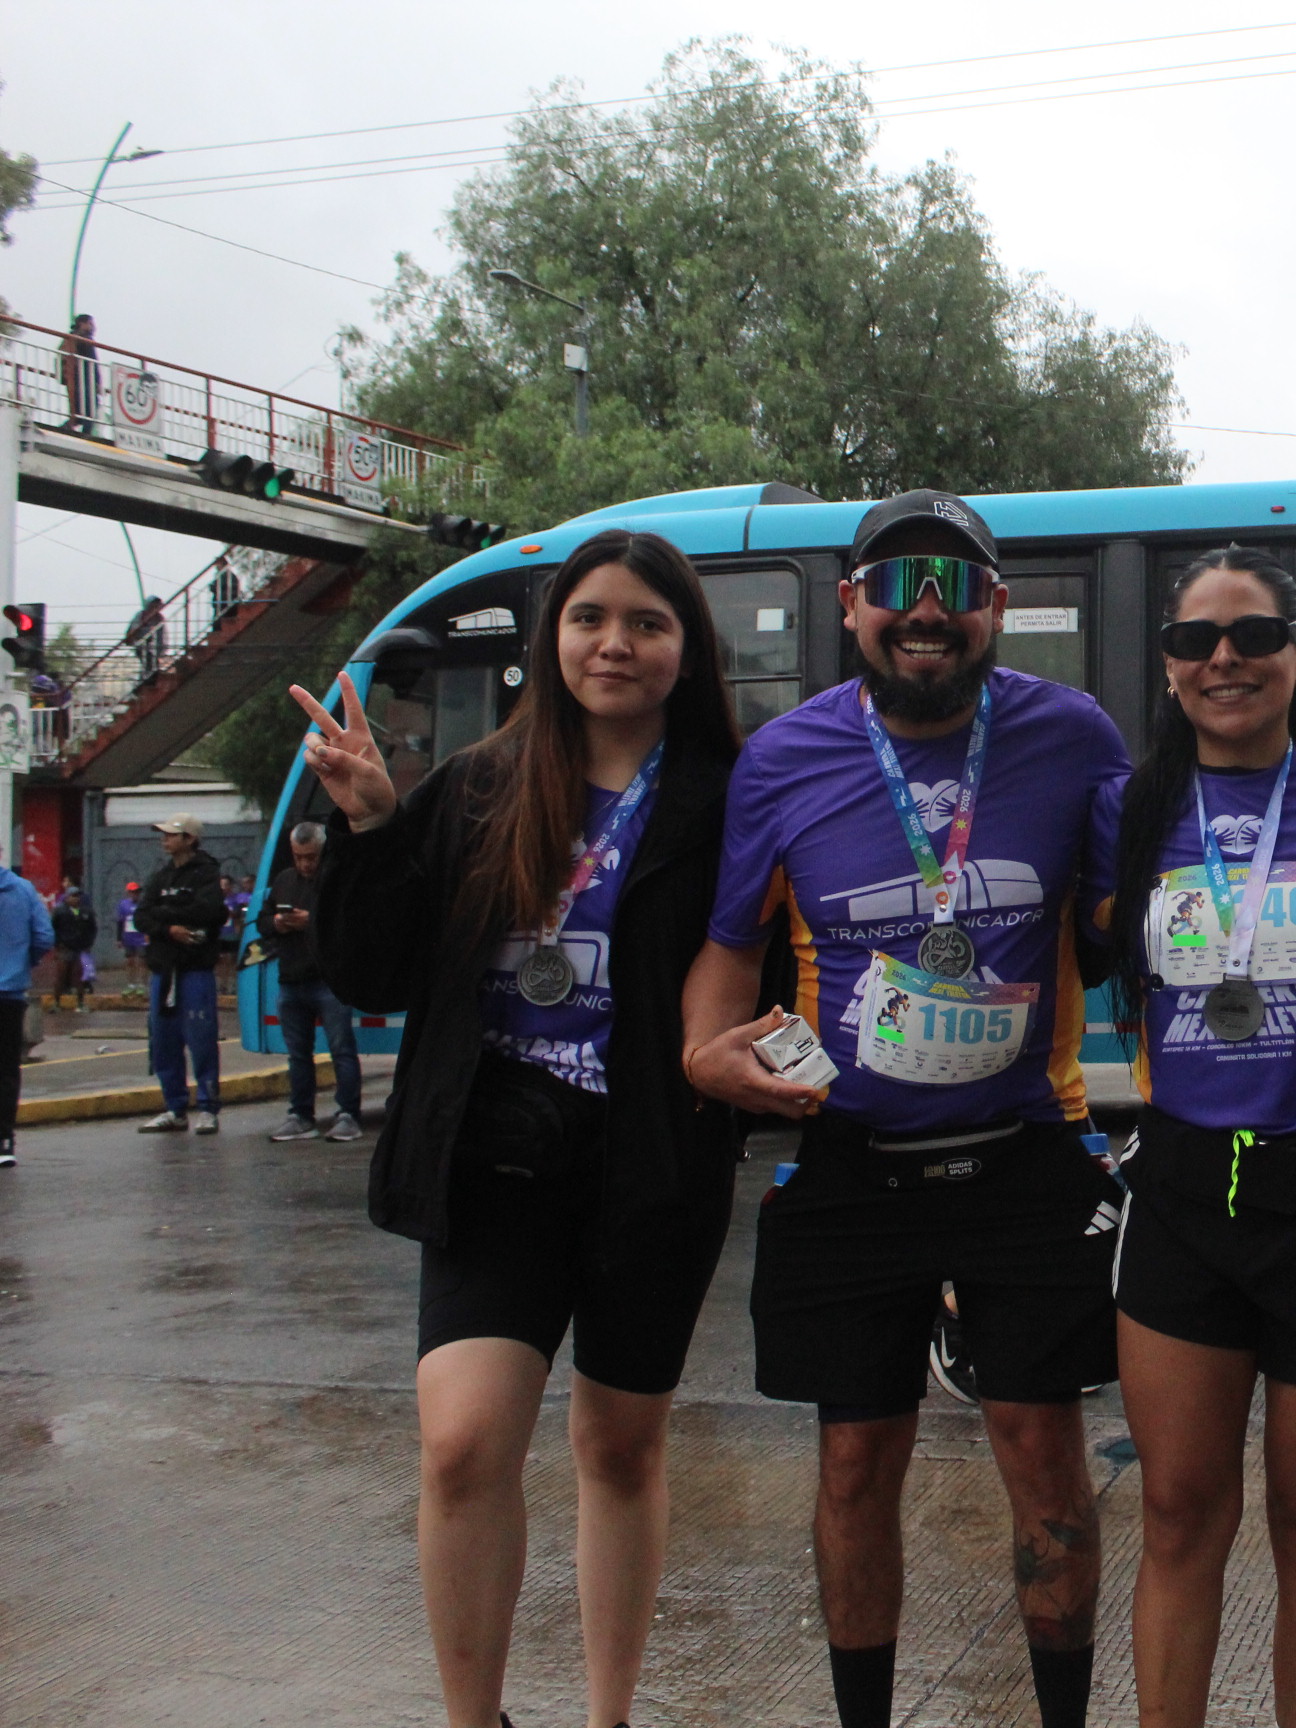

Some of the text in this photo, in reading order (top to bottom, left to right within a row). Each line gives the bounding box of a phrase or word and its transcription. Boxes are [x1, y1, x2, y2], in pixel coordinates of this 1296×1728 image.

[507, 670, 519, 682] 50
[960, 788, 972, 813] 2026
[908, 813, 923, 837] 2026
[593, 833, 611, 853] 2026
[1177, 874, 1198, 883] 2026
[1212, 863, 1225, 886] 2026
[827, 909, 1044, 941] TRANSCONICADOR
[892, 970, 907, 981] 2026
[919, 1003, 1013, 1045] 1105
[947, 1160, 973, 1169] ADIDAS
[949, 1167, 973, 1175] SPLITS
